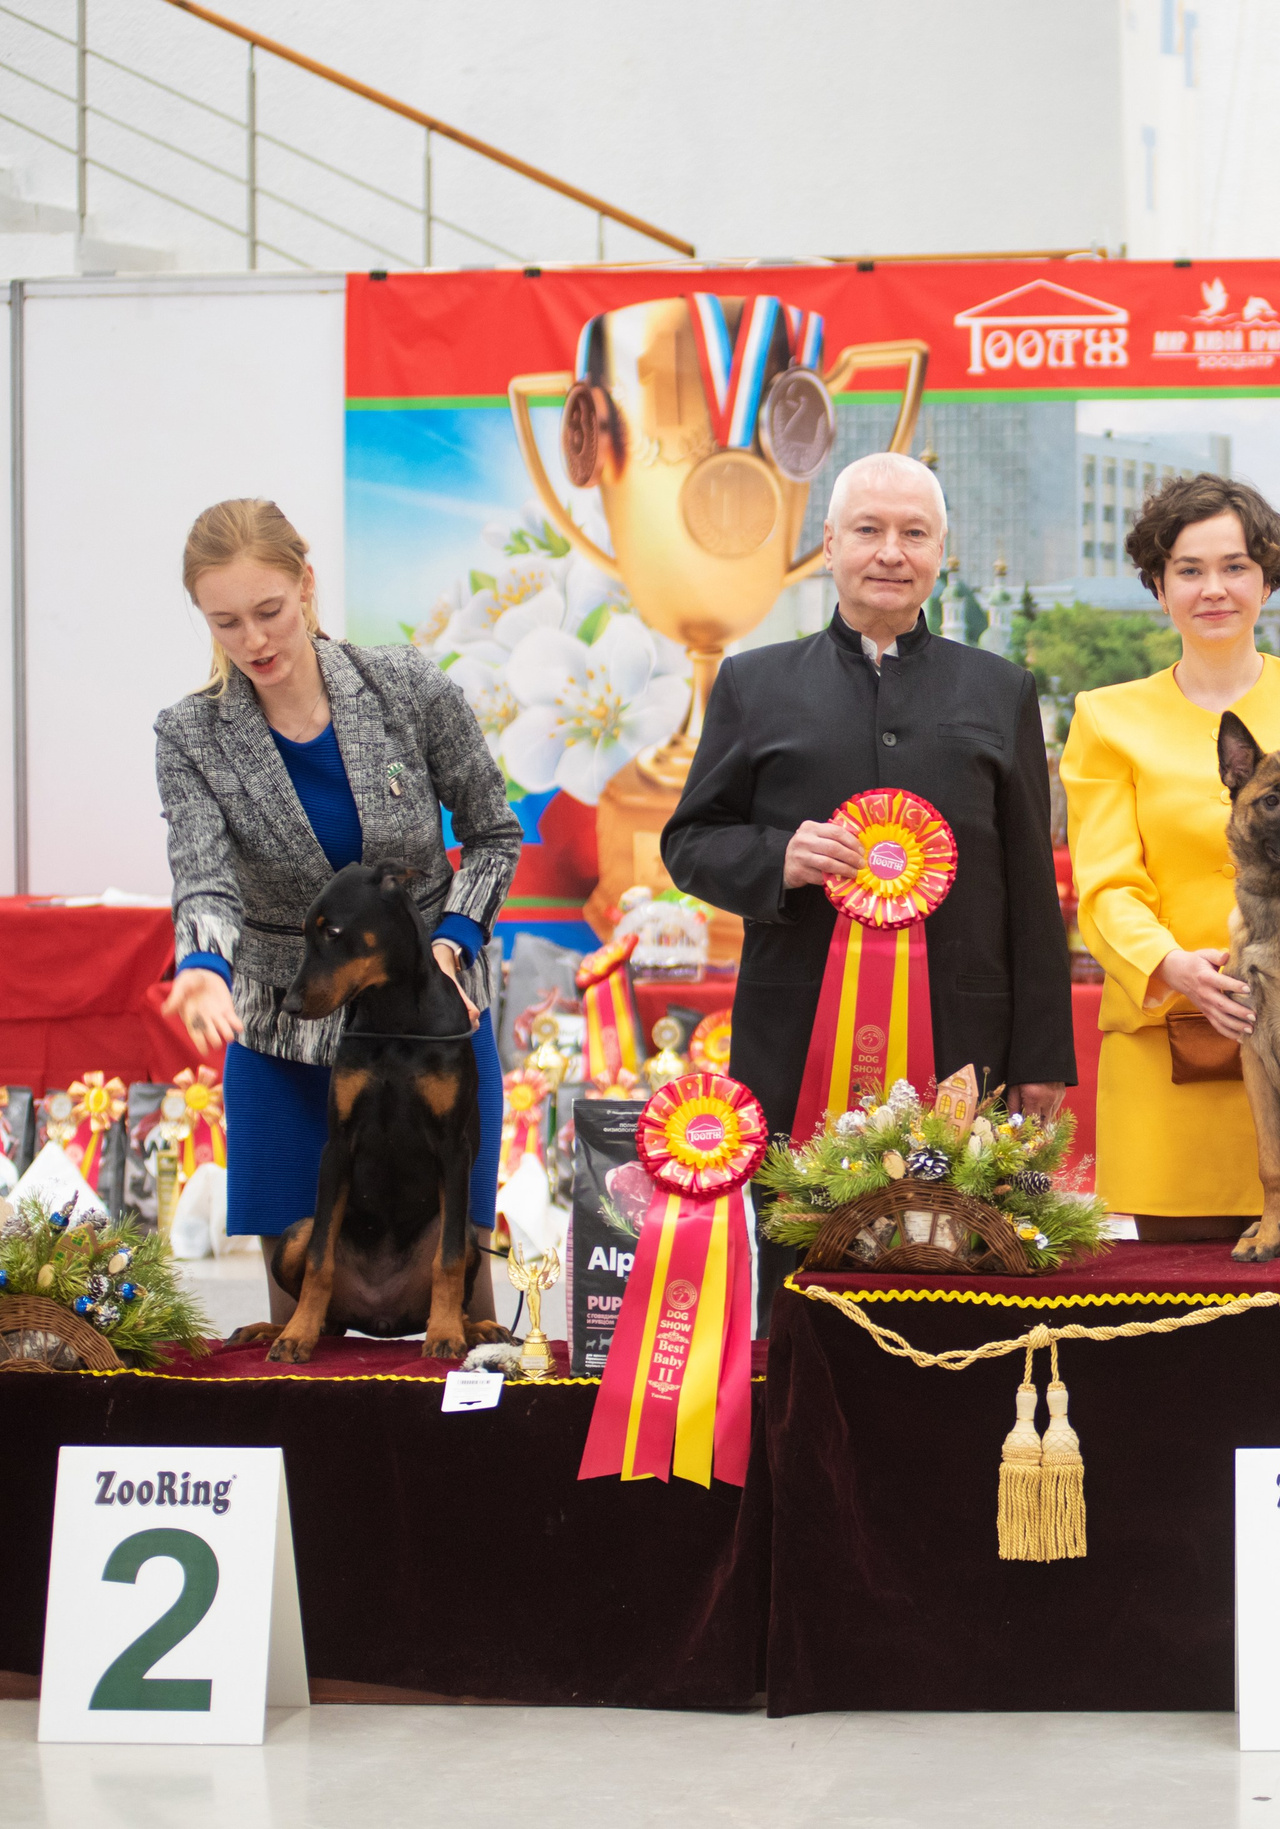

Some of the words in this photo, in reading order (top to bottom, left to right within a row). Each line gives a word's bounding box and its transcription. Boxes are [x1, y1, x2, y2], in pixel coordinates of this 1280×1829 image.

[1154, 331, 1188, 351] МИР
[858, 1054, 879, 1063] DOG
[853, 1065, 883, 1074] SHOW
[587, 1295, 623, 1311] PUP
[666, 1310, 689, 1321] DOG
[660, 1320, 691, 1332] SHOW
[658, 1340, 685, 1354] Best
[653, 1352, 685, 1370] Baby
[94, 1470, 233, 1516] ZooRing
[87, 1527, 220, 1712] 2
